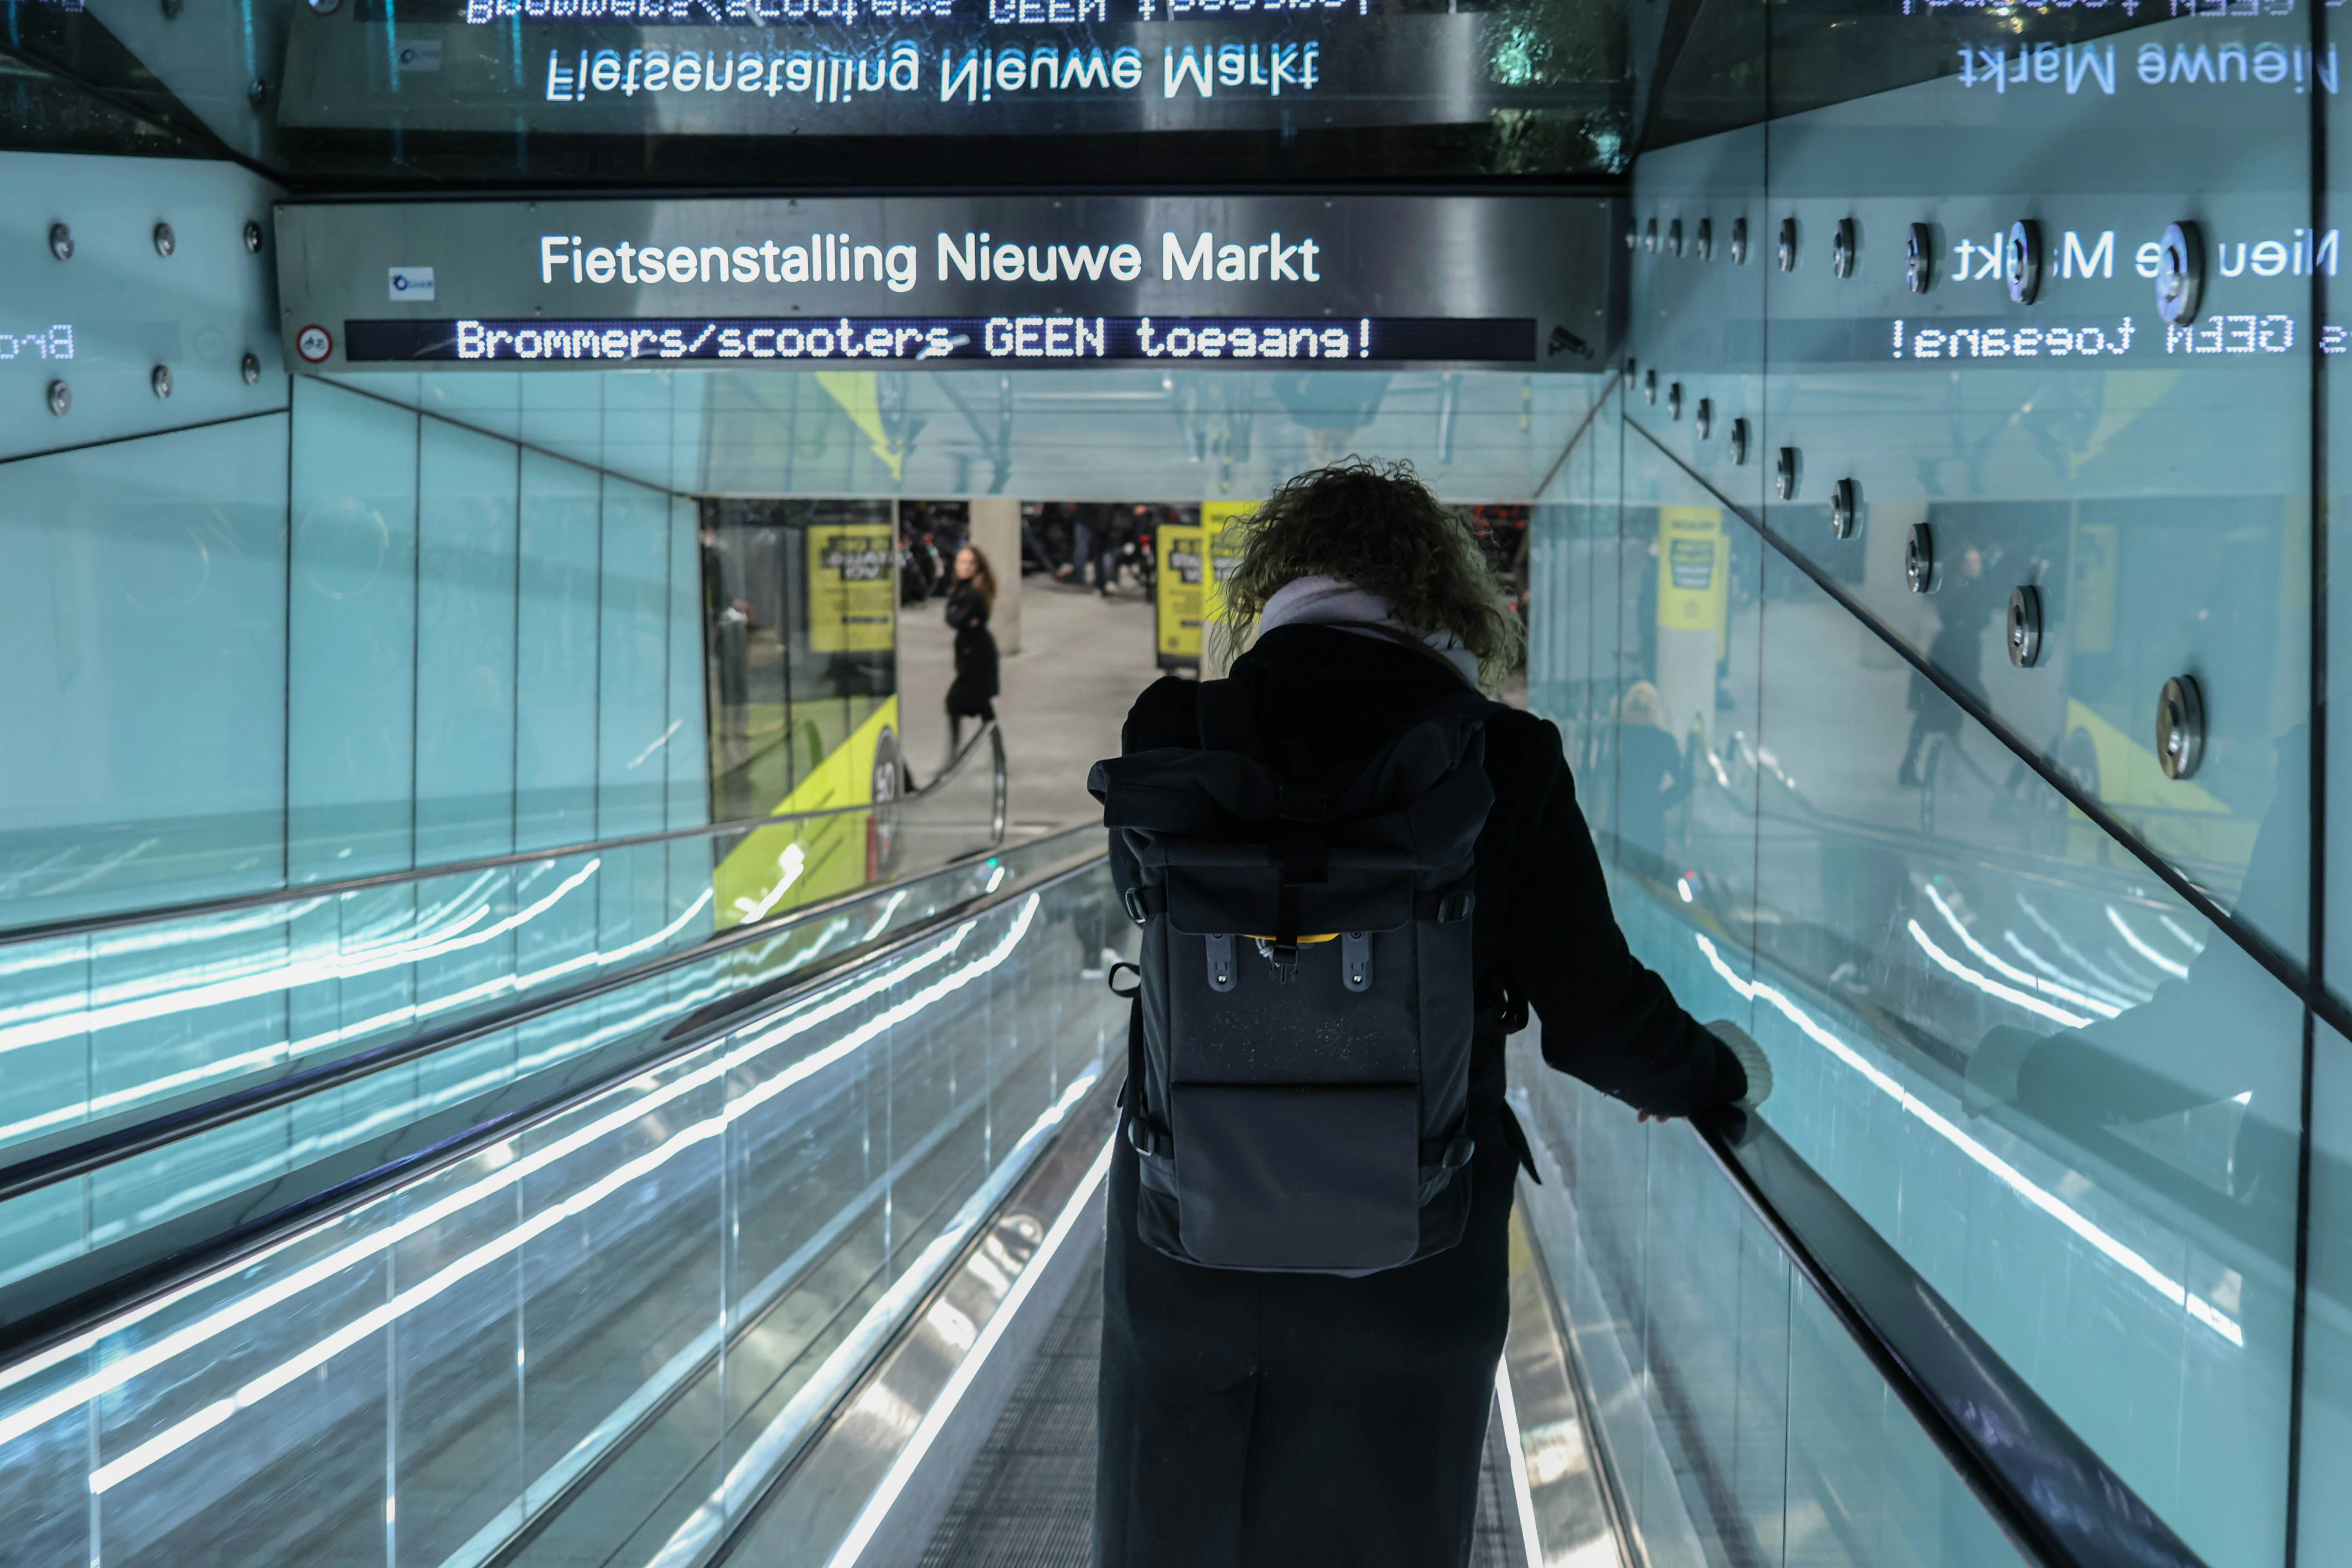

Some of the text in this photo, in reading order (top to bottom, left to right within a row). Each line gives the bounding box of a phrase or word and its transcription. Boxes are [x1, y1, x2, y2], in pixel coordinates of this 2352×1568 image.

[1957, 41, 2116, 94] Markt
[541, 232, 1320, 293] Fietsenstalling Nieuwe Markt
[456, 318, 954, 359] Brommers/scooters
[985, 317, 1104, 358] GEEN
